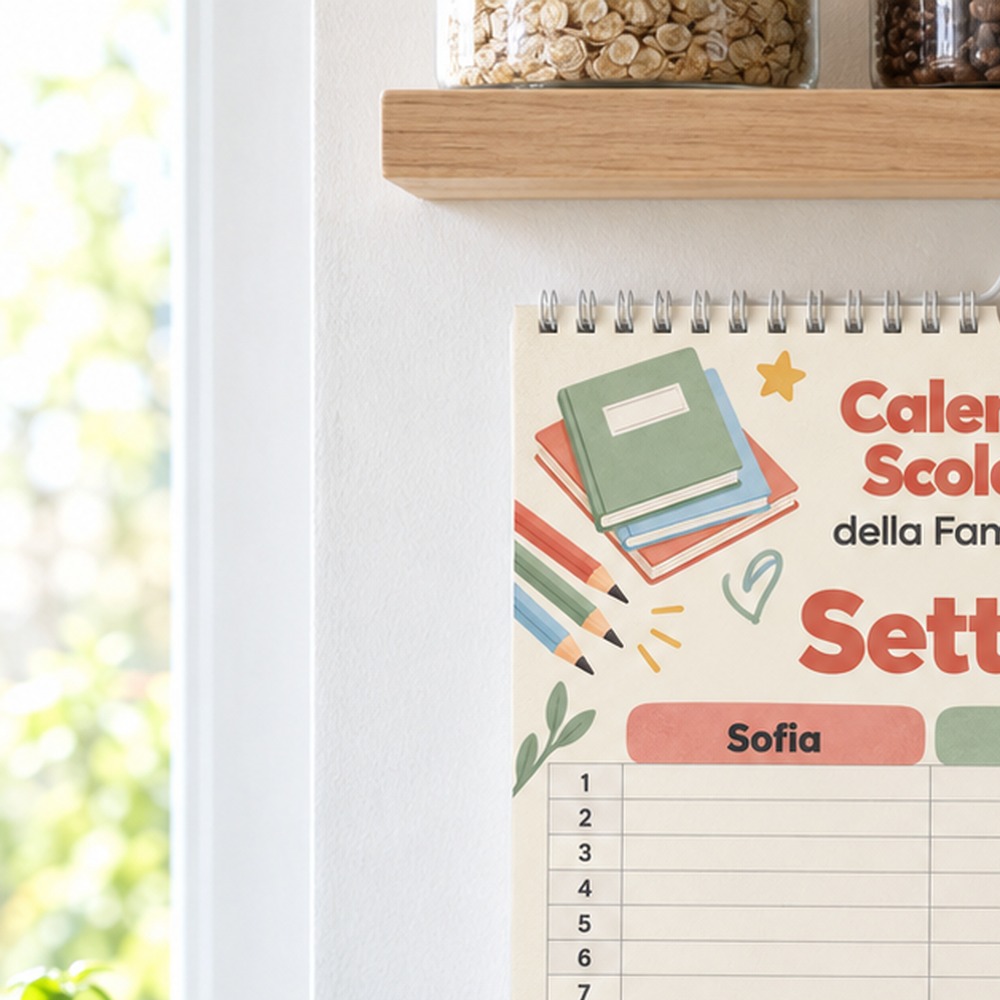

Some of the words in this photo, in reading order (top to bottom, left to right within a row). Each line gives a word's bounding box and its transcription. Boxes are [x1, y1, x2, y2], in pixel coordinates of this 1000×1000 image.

[833, 515, 922, 546] della
[726, 721, 821, 753] Sofia
[580, 772, 590, 793] 1
[578, 807, 593, 828] 2
[578, 842, 592, 863] 3
[577, 878, 593, 898] 4
[577, 913, 592, 934] 5
[577, 947, 592, 968] 6
